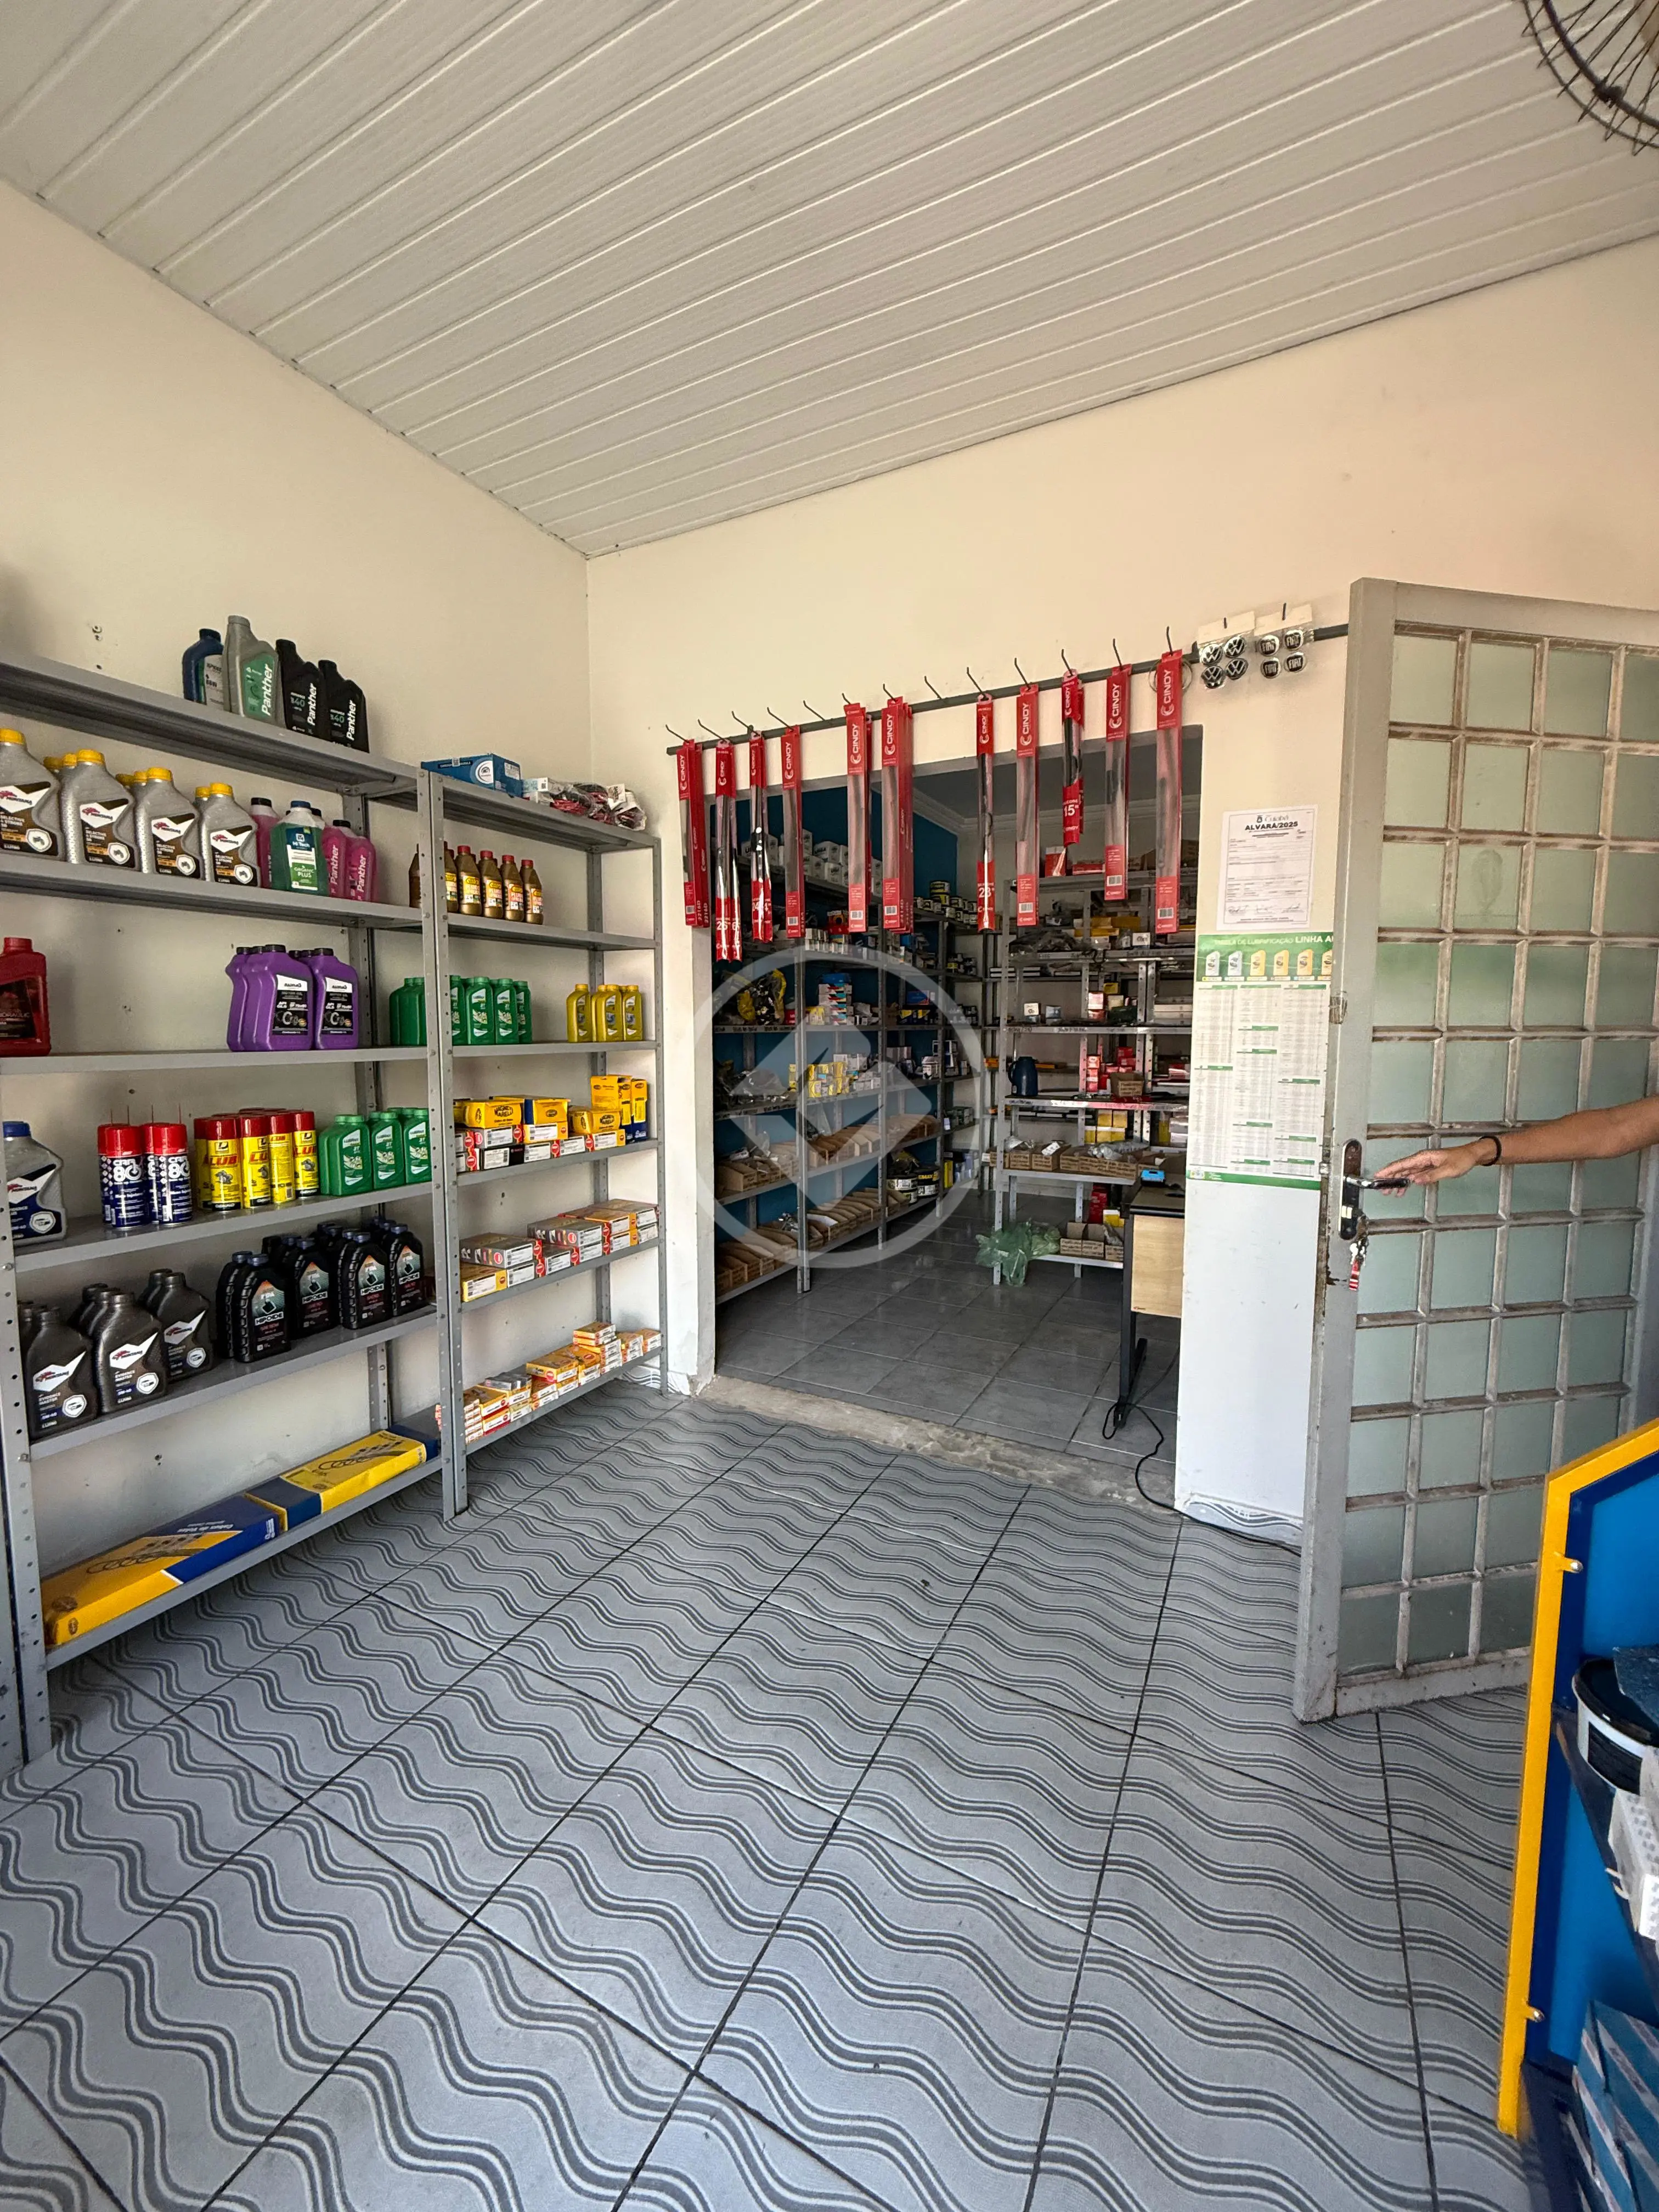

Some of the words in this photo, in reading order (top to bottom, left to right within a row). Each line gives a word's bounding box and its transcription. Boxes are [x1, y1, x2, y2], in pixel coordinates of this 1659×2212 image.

[261, 664, 273, 716] Panther
[307, 683, 318, 726] Panther
[1163, 669, 1172, 704] CINDY
[346, 699, 357, 741] Panther
[330, 845, 339, 885] Panther
[357, 855, 366, 893] Panther
[1295, 935, 1323, 943] LINHA
[113, 1164, 142, 1182] 80
[255, 1311, 284, 1325] HIPOIDE
